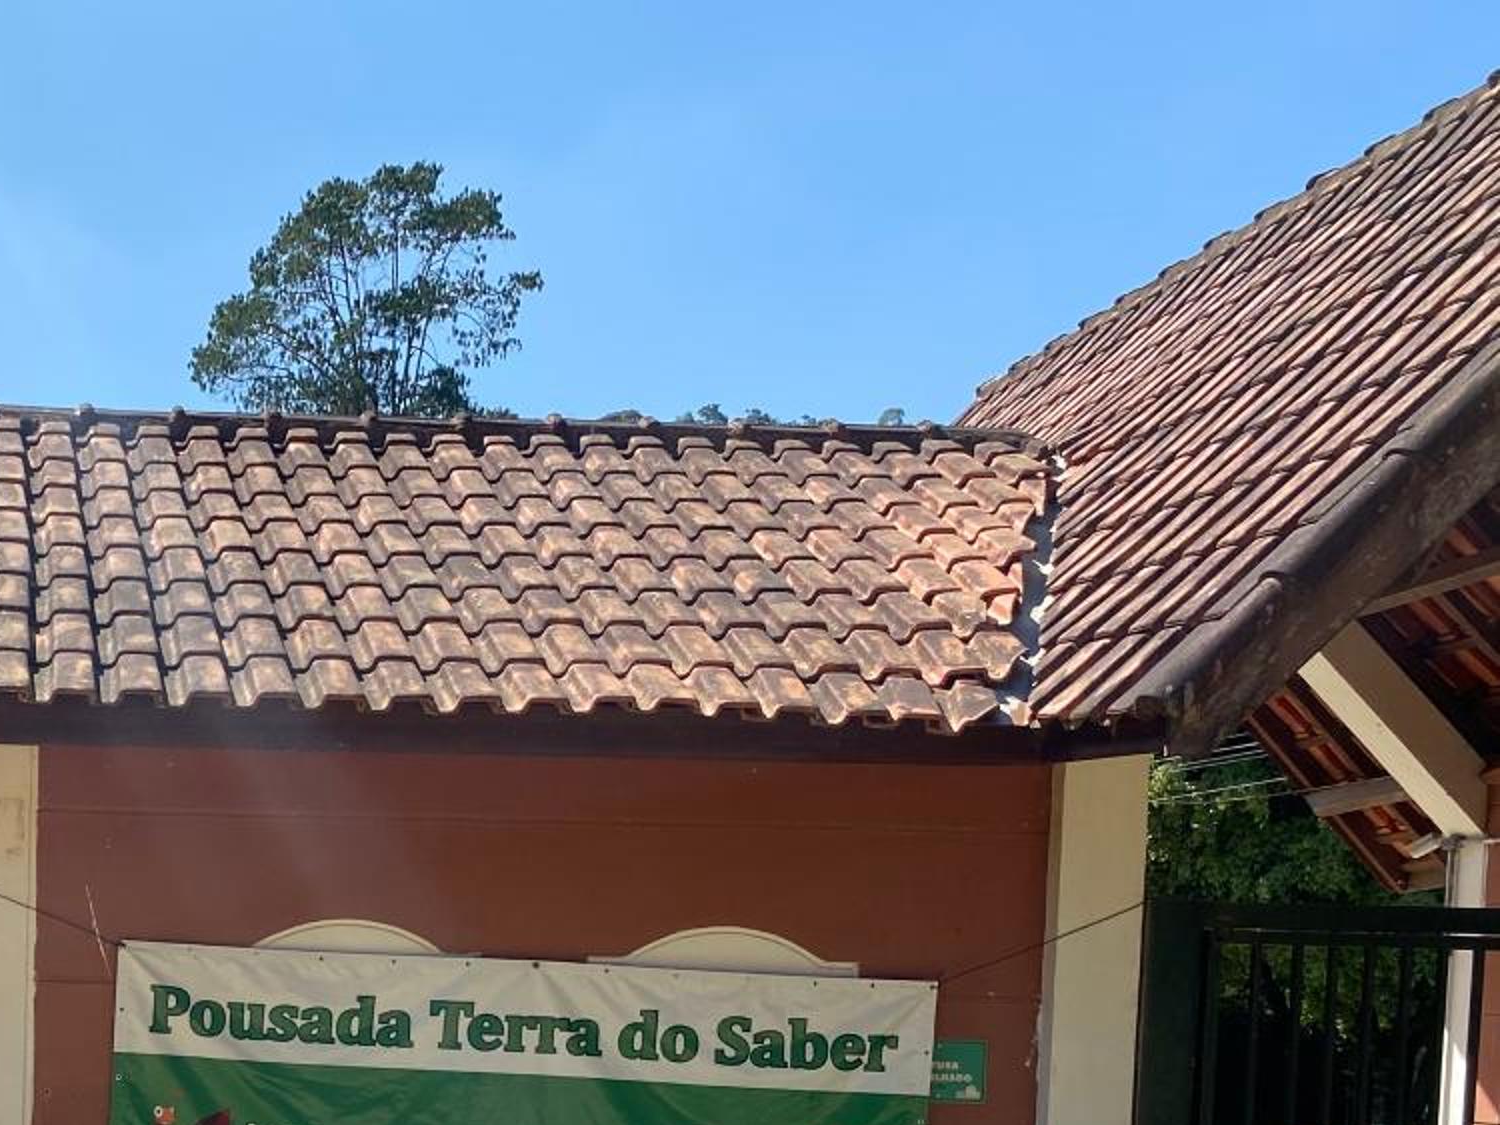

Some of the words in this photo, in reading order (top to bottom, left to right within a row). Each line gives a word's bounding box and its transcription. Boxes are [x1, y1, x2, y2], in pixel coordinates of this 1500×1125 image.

[148, 984, 414, 1049] Pousada
[429, 999, 602, 1058] Terra
[617, 1010, 699, 1063] do
[713, 1016, 899, 1073] Saber
